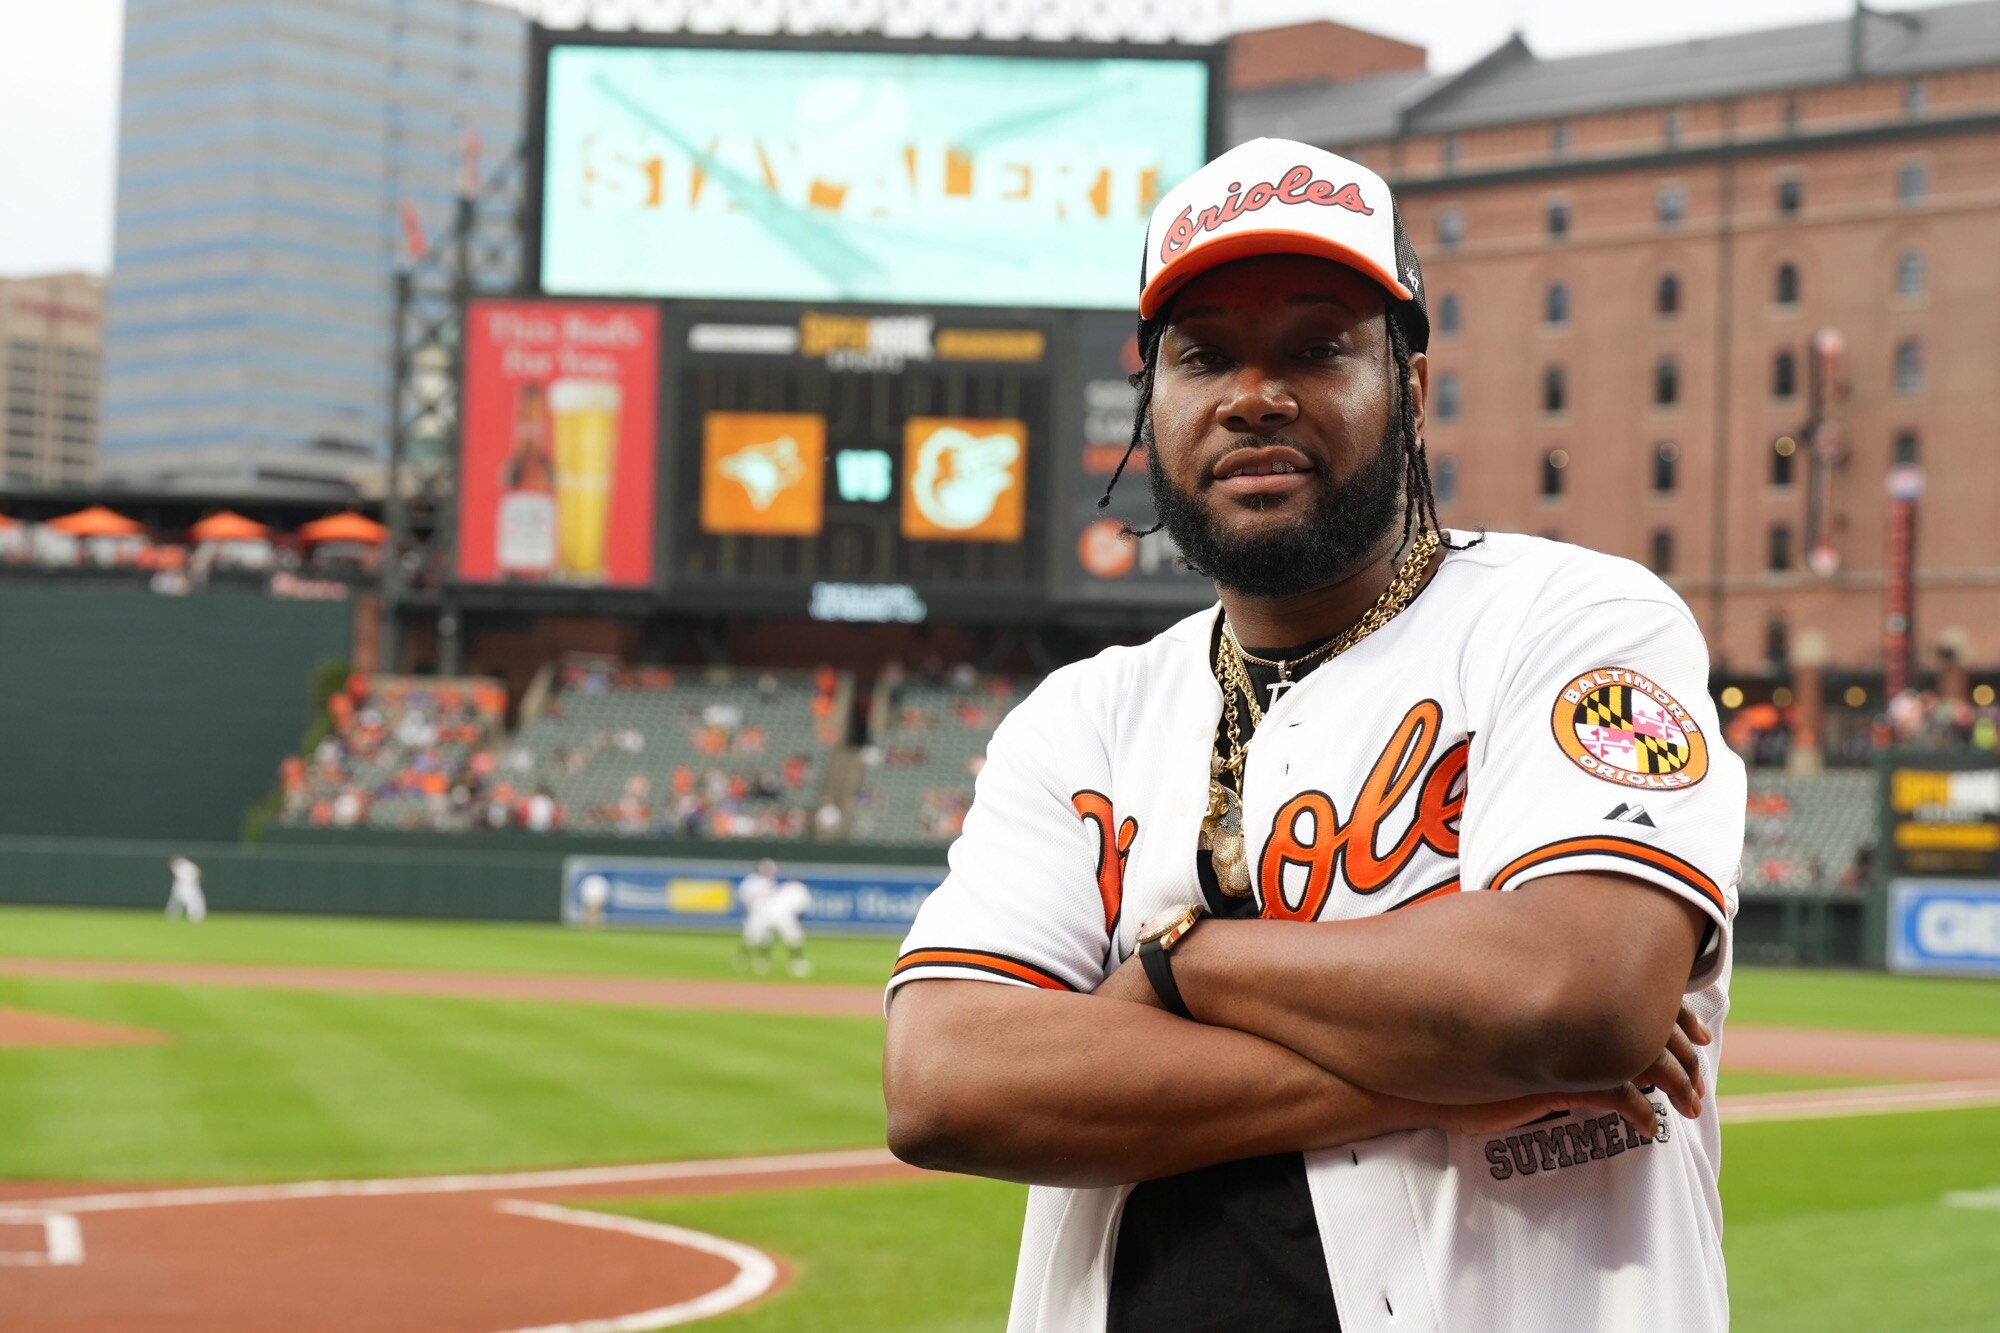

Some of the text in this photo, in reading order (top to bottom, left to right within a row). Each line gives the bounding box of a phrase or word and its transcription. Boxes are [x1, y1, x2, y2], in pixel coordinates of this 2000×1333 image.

[1160, 164, 1375, 265] Orioles
[1563, 670, 1699, 734] BALTIMORE
[1578, 753, 1693, 788] ORIOLES
